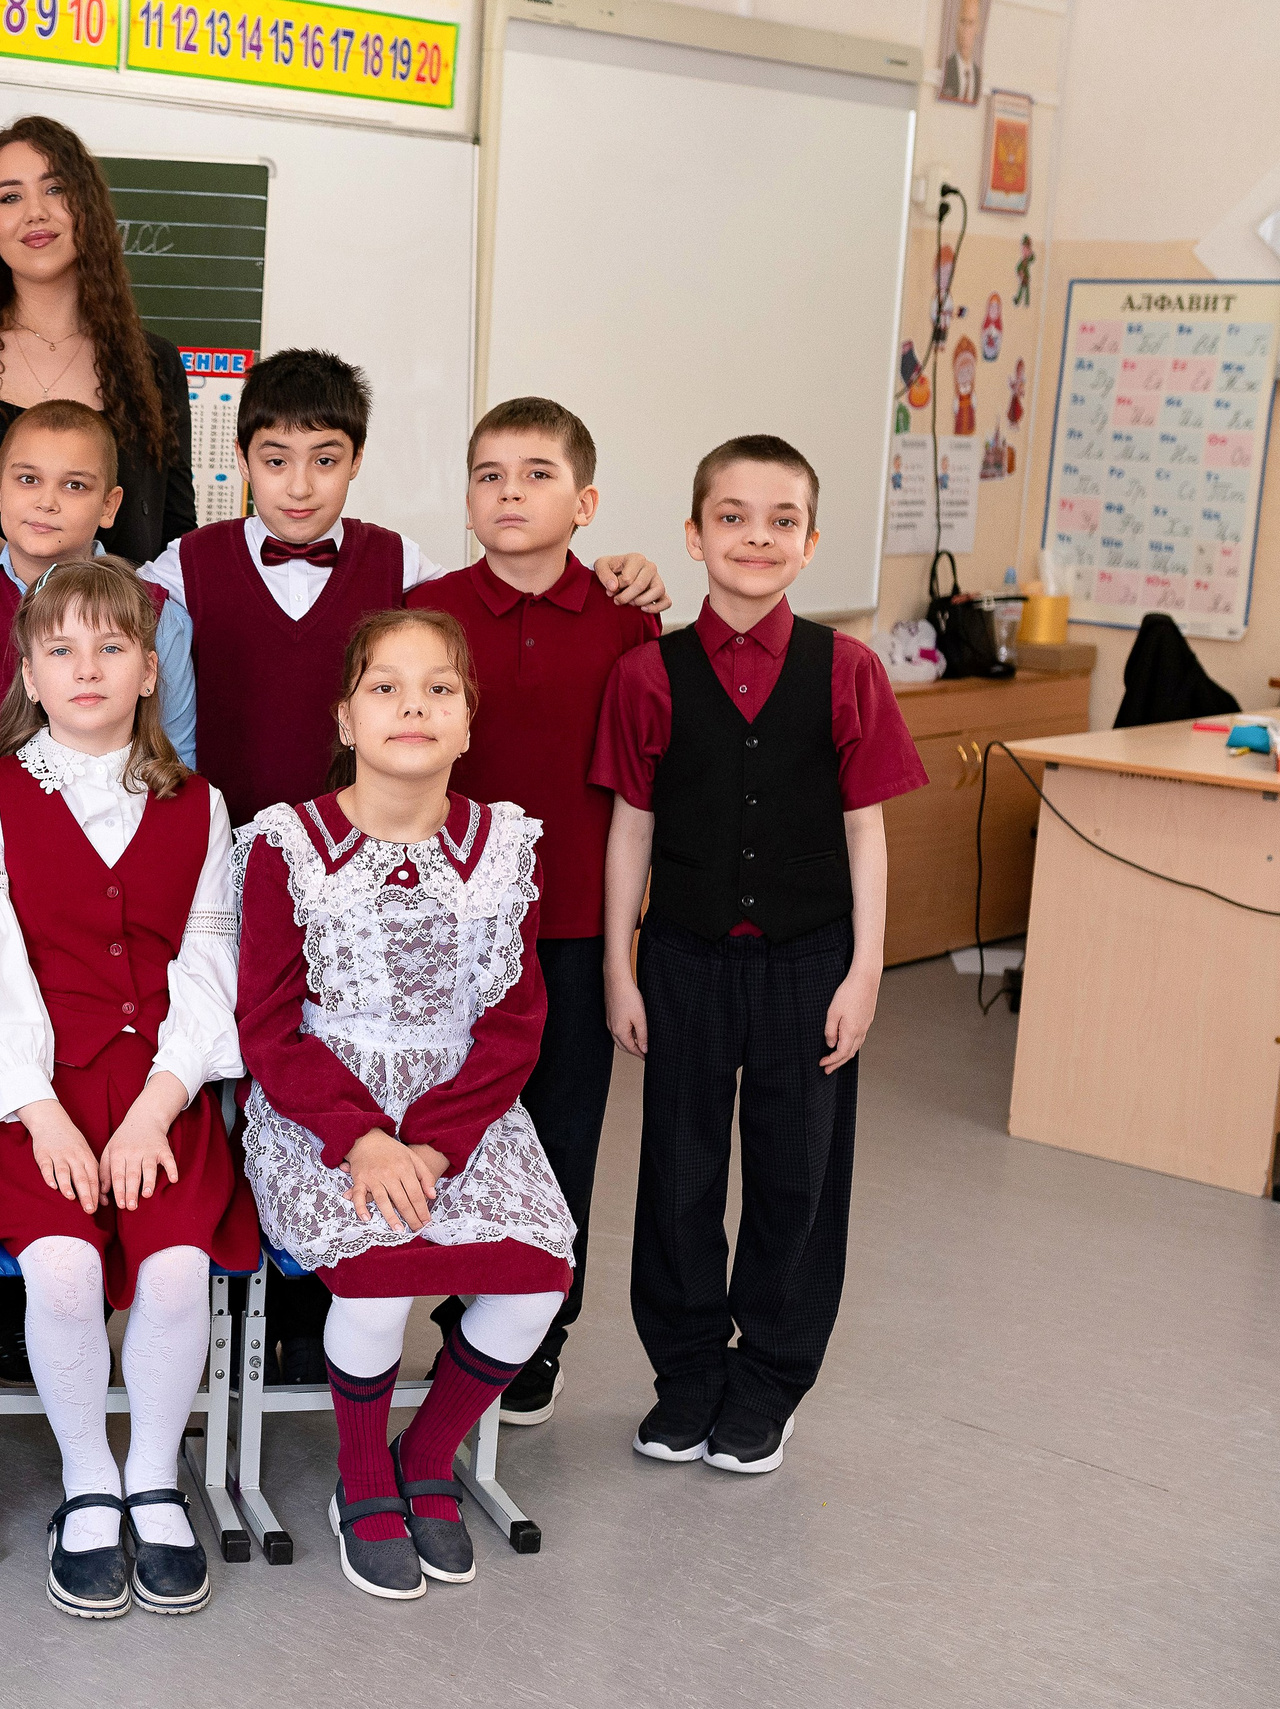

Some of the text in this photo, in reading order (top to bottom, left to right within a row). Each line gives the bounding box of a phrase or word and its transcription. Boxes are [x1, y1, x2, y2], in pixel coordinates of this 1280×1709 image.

[4, 0, 27, 34] 8
[35, 0, 58, 38] 9
[71, 0, 106, 44] 10
[140, 0, 441, 85] 11 12 13 14 15 16 17 18 19 20
[1120, 293, 1237, 313] АЛФАВИТ
[181, 352, 246, 373] ЕНИЕ
